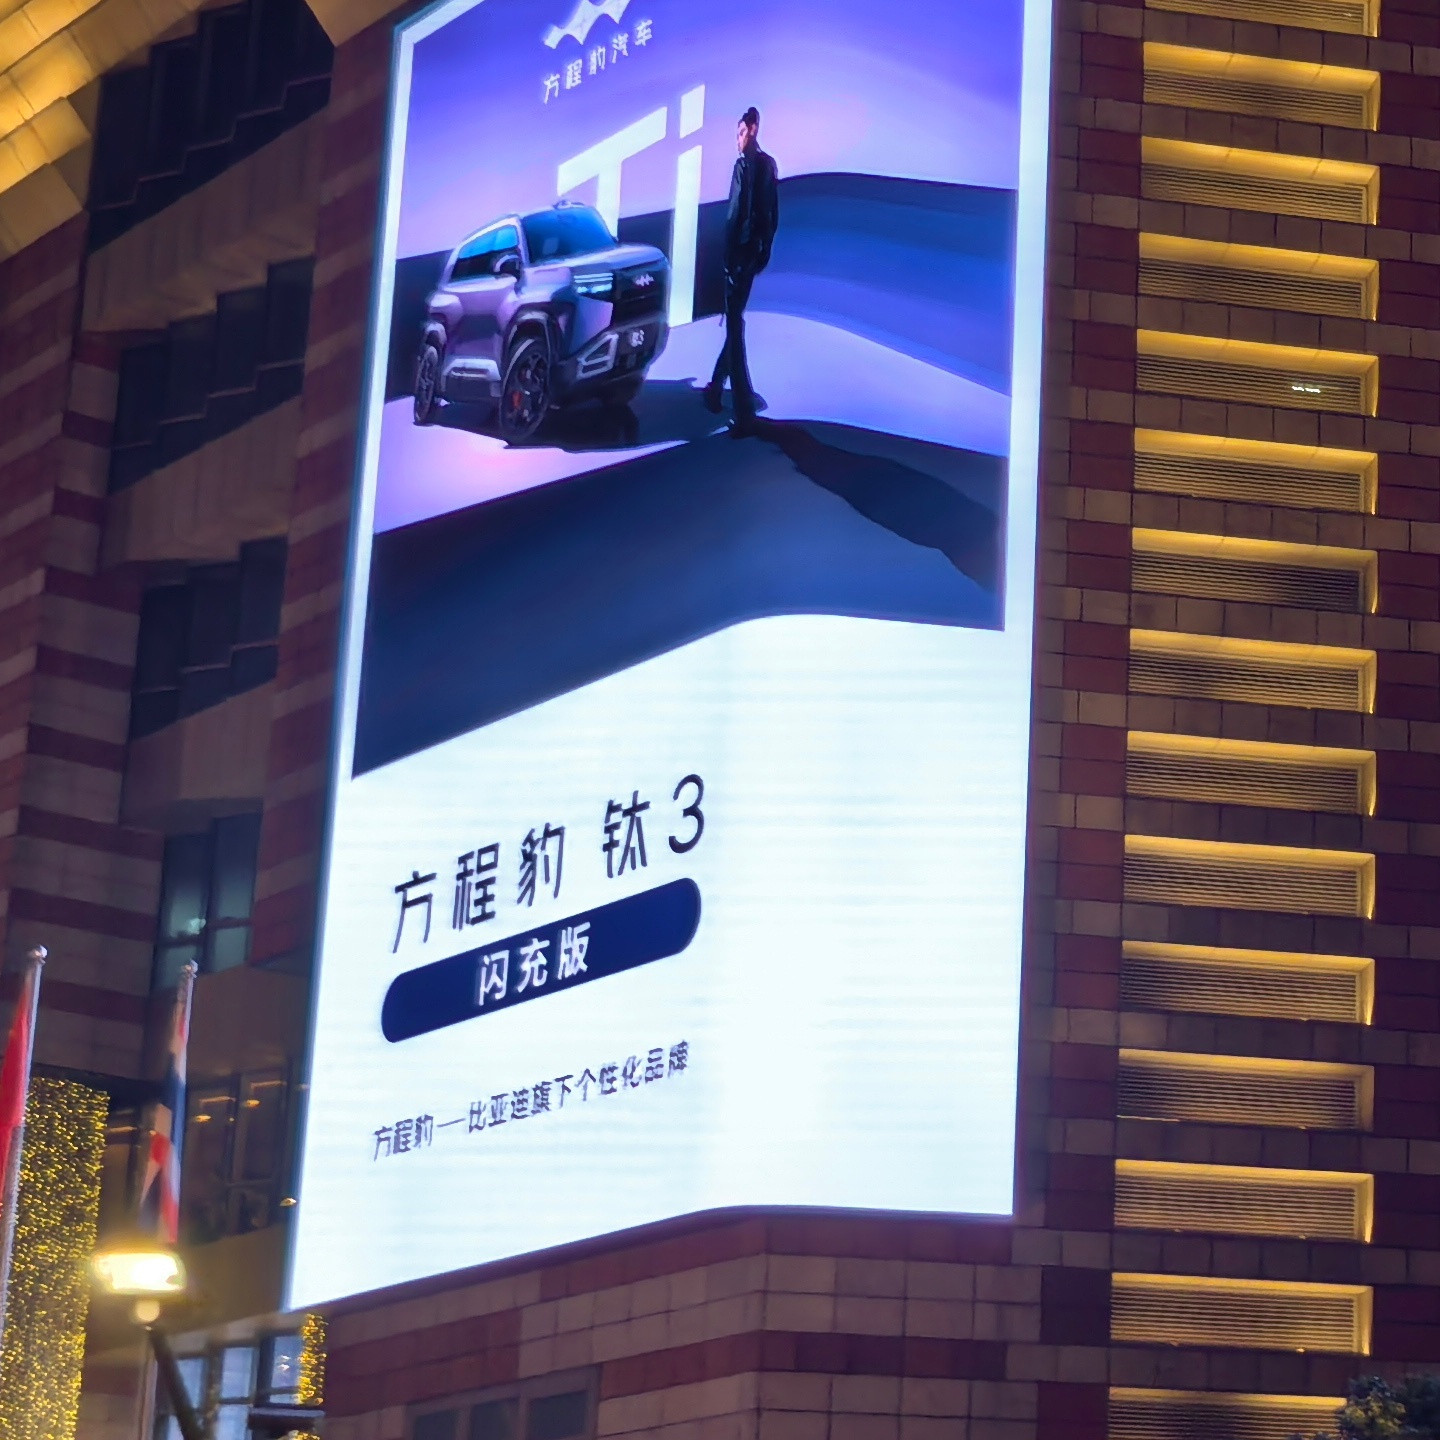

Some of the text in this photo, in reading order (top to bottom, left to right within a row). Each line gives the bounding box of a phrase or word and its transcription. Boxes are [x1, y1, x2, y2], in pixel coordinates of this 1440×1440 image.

[557, 84, 705, 328] Ti
[391, 821, 566, 954] 方程豹
[477, 922, 591, 1006] 闪充版
